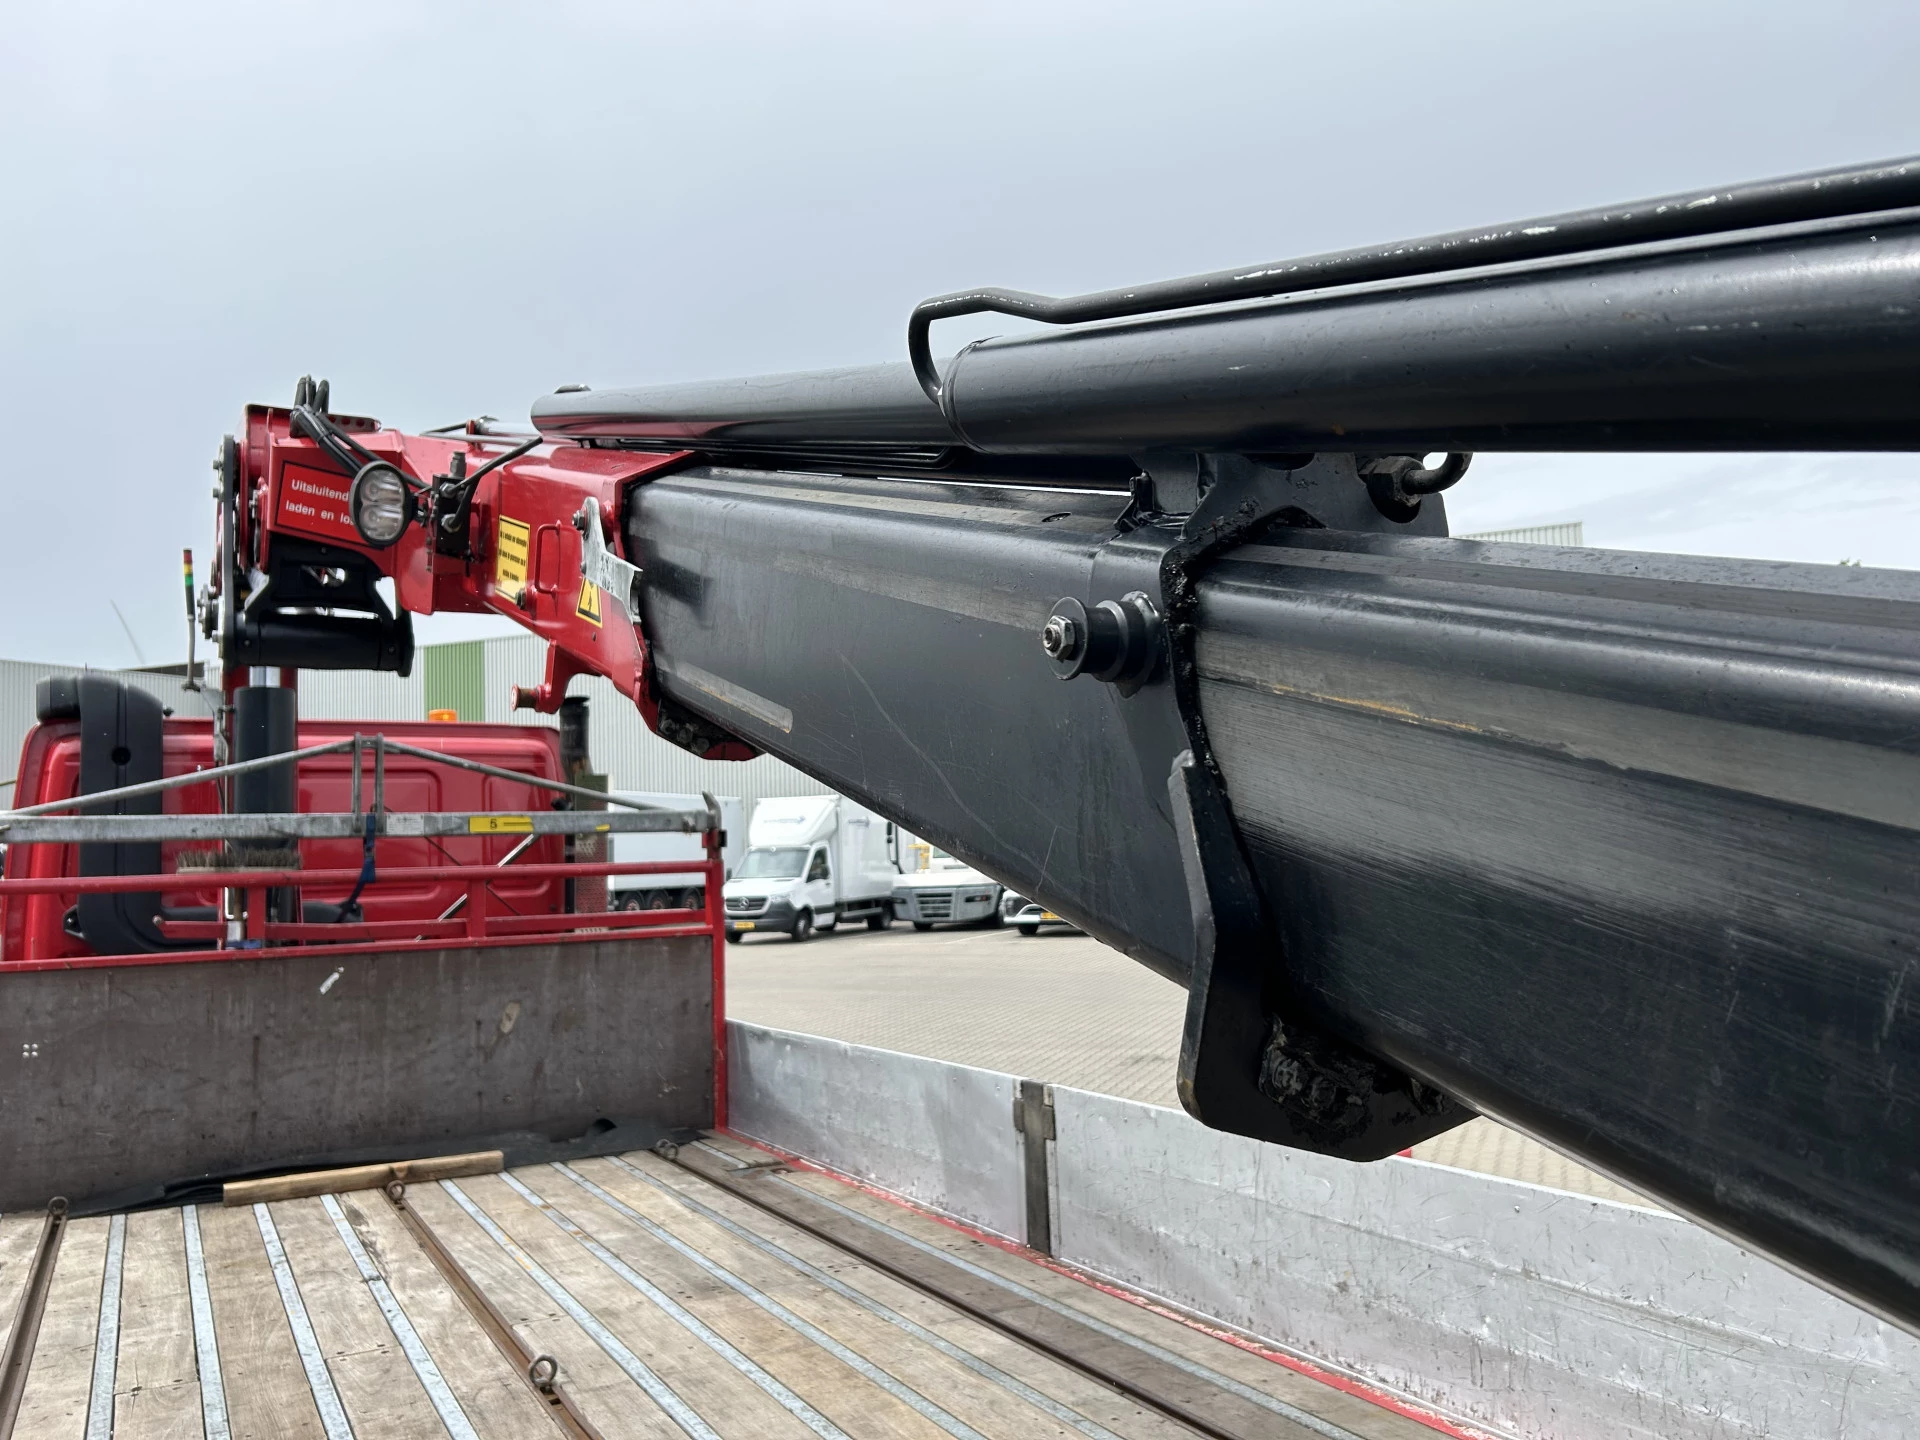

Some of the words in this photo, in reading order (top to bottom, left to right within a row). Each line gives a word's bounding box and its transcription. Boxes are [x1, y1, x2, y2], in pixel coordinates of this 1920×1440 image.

[291, 479, 350, 502] Uitsluitend
[286, 500, 315, 516] laden
[321, 510, 335, 521] en
